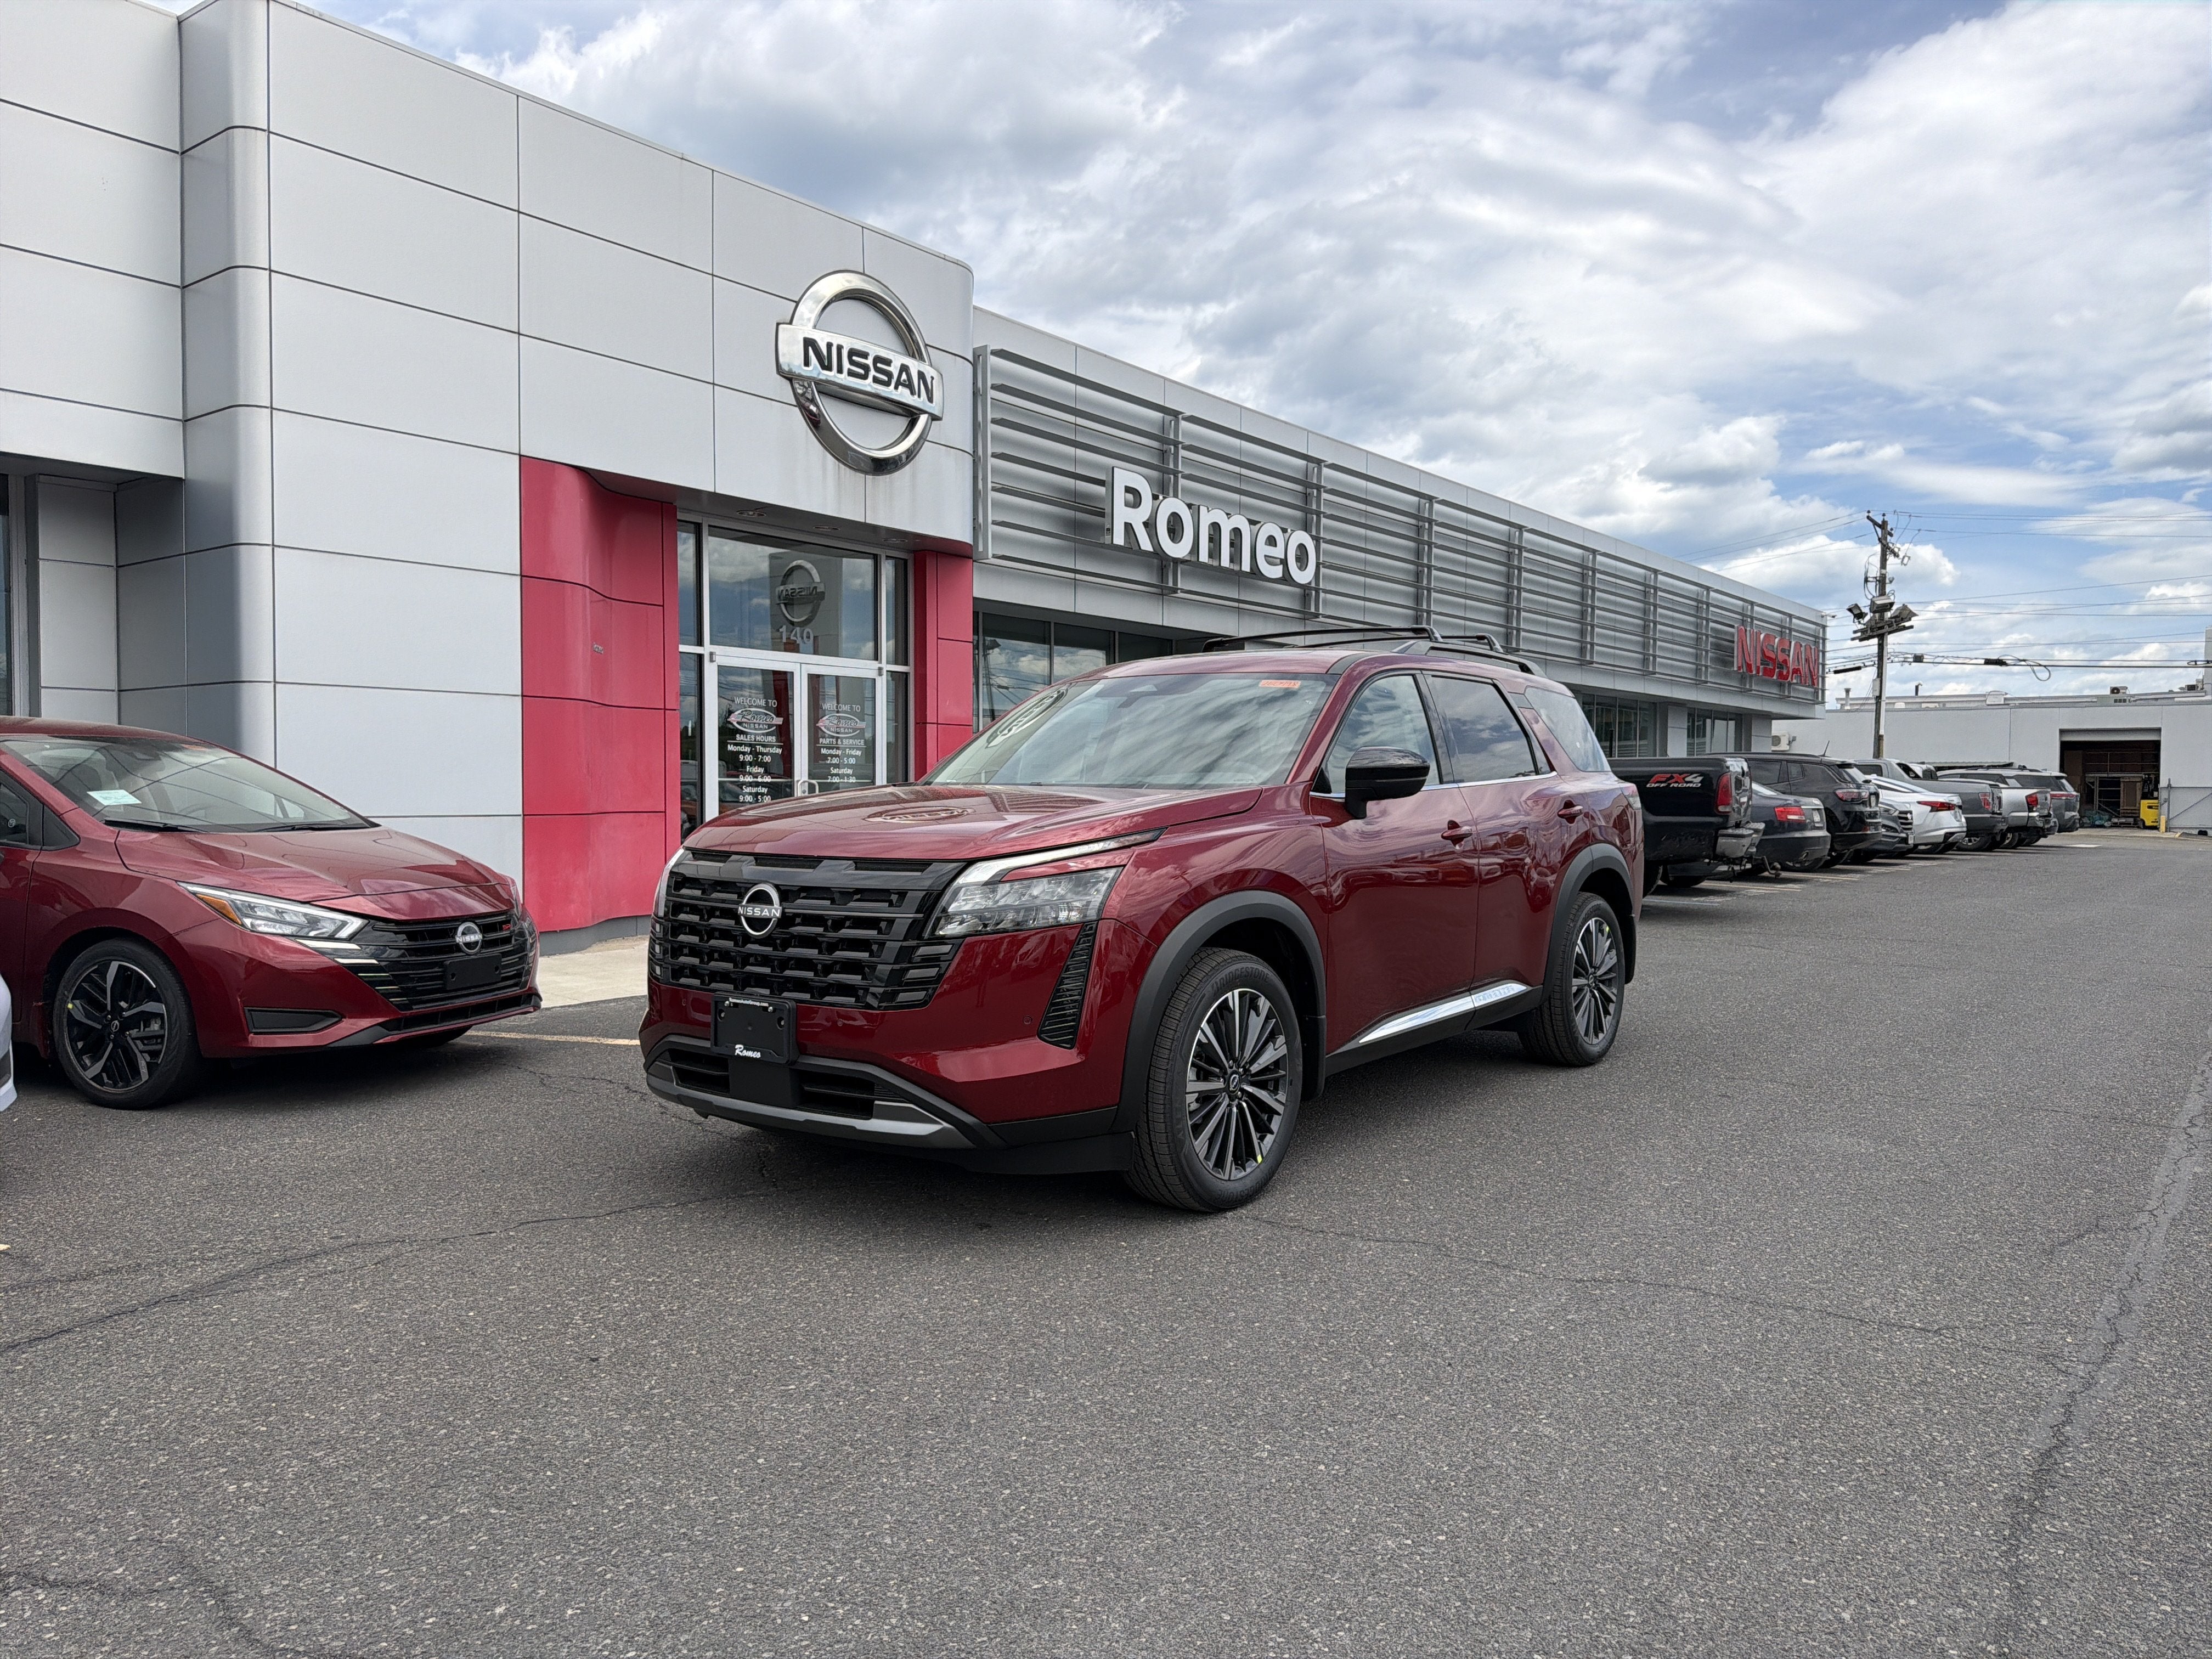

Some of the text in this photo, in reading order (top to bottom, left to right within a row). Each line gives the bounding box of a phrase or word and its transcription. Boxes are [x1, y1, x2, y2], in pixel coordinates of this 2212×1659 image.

[803, 336, 935, 404] NISSAN
[1111, 466, 1317, 585] Romeo
[779, 625, 814, 644] 140
[1737, 625, 1818, 688] NISSAN
[734, 697, 777, 708] WELCOME TO
[822, 703, 851, 712] WELCOME
[738, 709, 774, 723] Romeo
[828, 716, 858, 727] Romeo
[727, 744, 751, 753] Monday
[756, 746, 782, 755] Thursday
[821, 748, 842, 756] Monday
[846, 748, 862, 757] Friday
[746, 765, 764, 774] Friday
[1650, 773, 1704, 784] FX4
[742, 785, 768, 794] Saturday
[738, 906, 780, 917] NISSAN
[455, 933, 483, 943] NISSAN
[735, 1044, 761, 1058] Romeo
